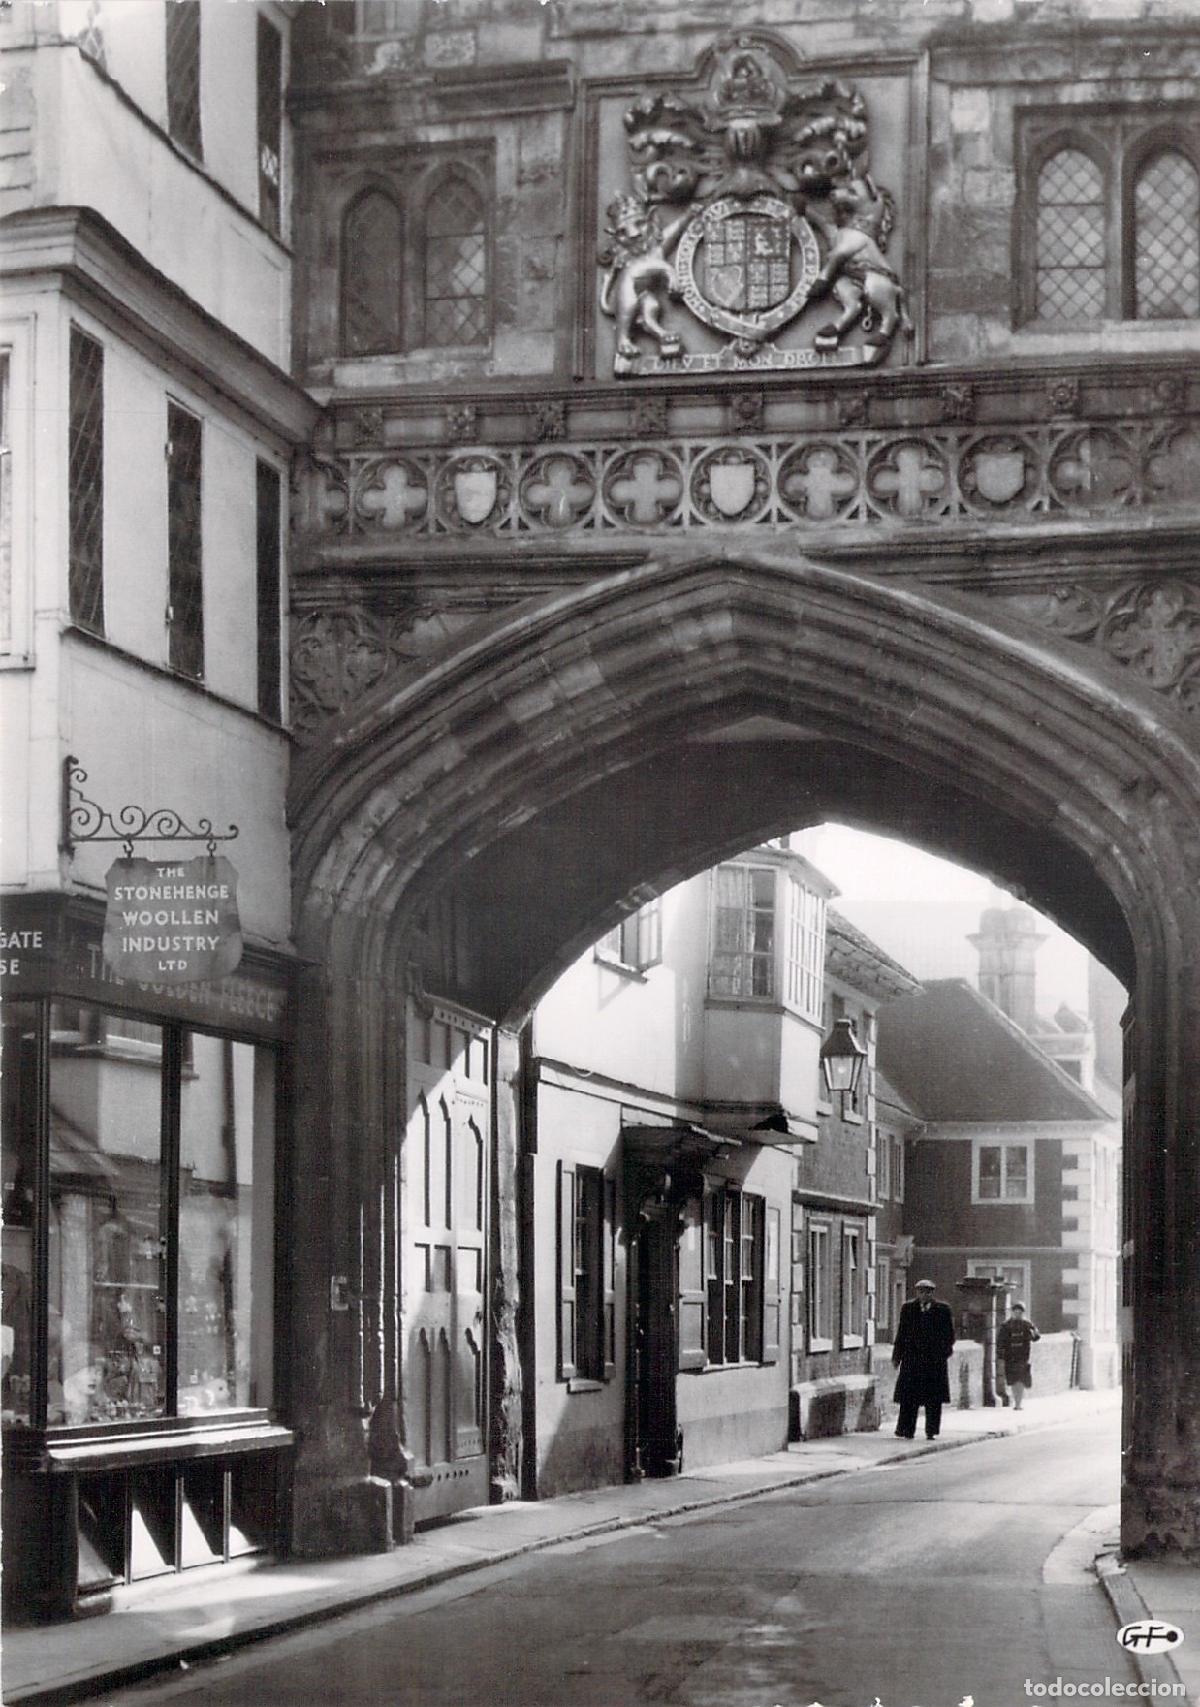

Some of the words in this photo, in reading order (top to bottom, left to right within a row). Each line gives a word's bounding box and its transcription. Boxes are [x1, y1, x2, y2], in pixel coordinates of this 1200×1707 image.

[157, 867, 185, 878] THE
[114, 885, 229, 901] STONEHENGE
[123, 910, 219, 926] WOOLLEN
[0, 931, 43, 949] GATE
[122, 936, 220, 952] INDUSTRY
[158, 960, 188, 971] LTD
